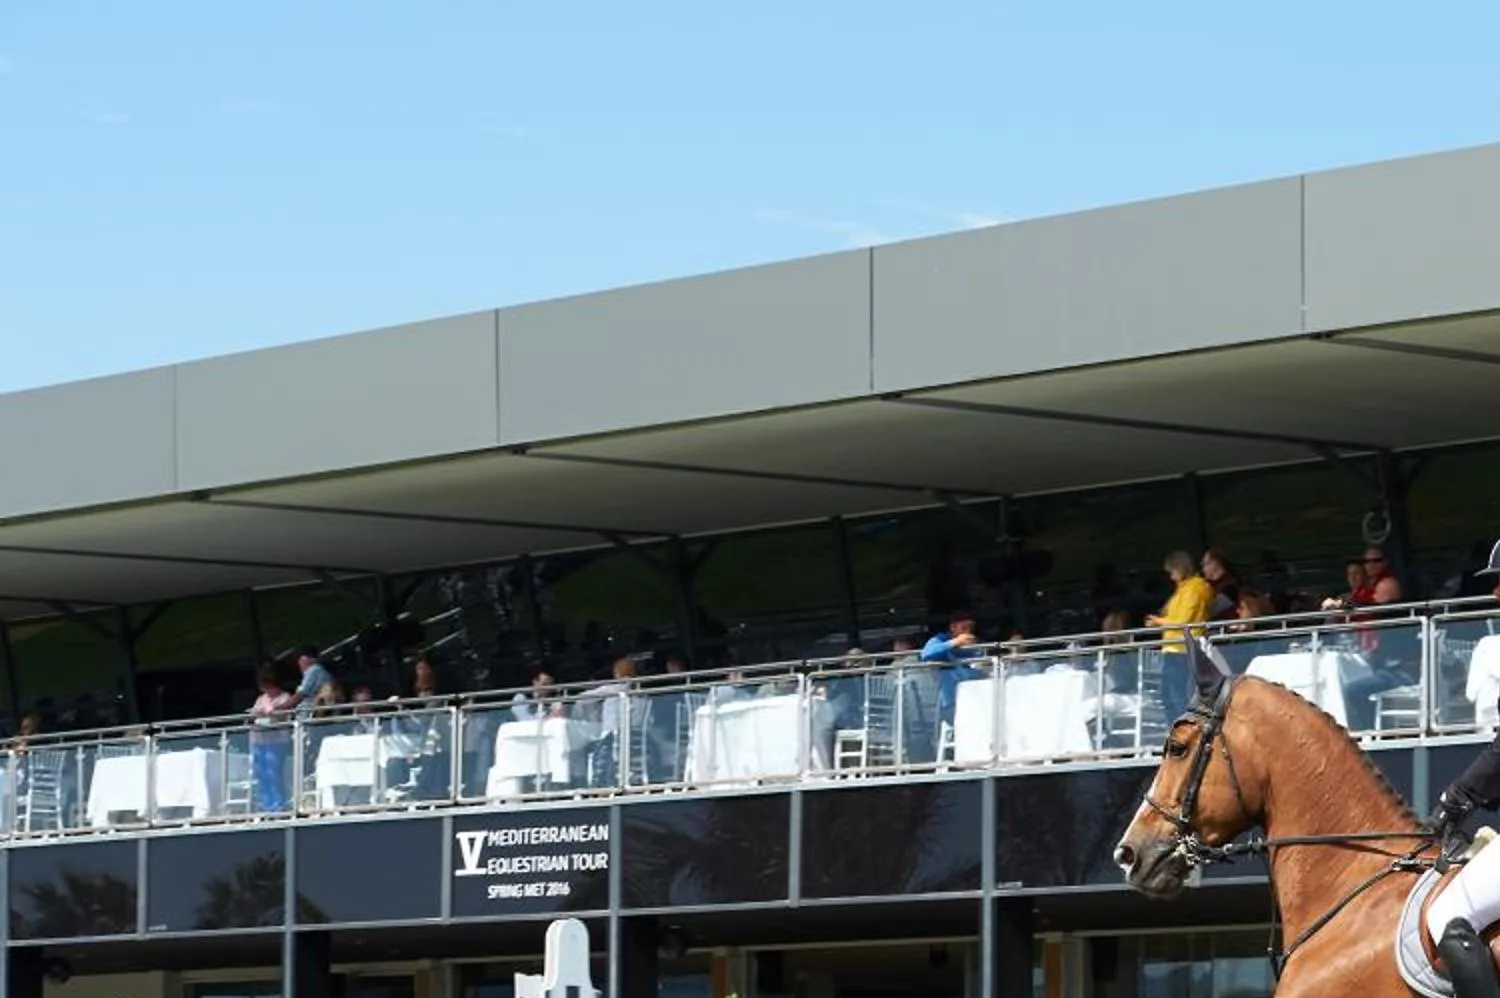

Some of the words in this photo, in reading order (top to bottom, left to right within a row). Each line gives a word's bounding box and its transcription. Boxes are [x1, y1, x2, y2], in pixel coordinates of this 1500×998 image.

[487, 824, 609, 846] MEDITERRANEAN
[487, 855, 569, 875] EQUESTRIAN
[573, 852, 609, 870] TOUR
[487, 883, 523, 899] SPRING
